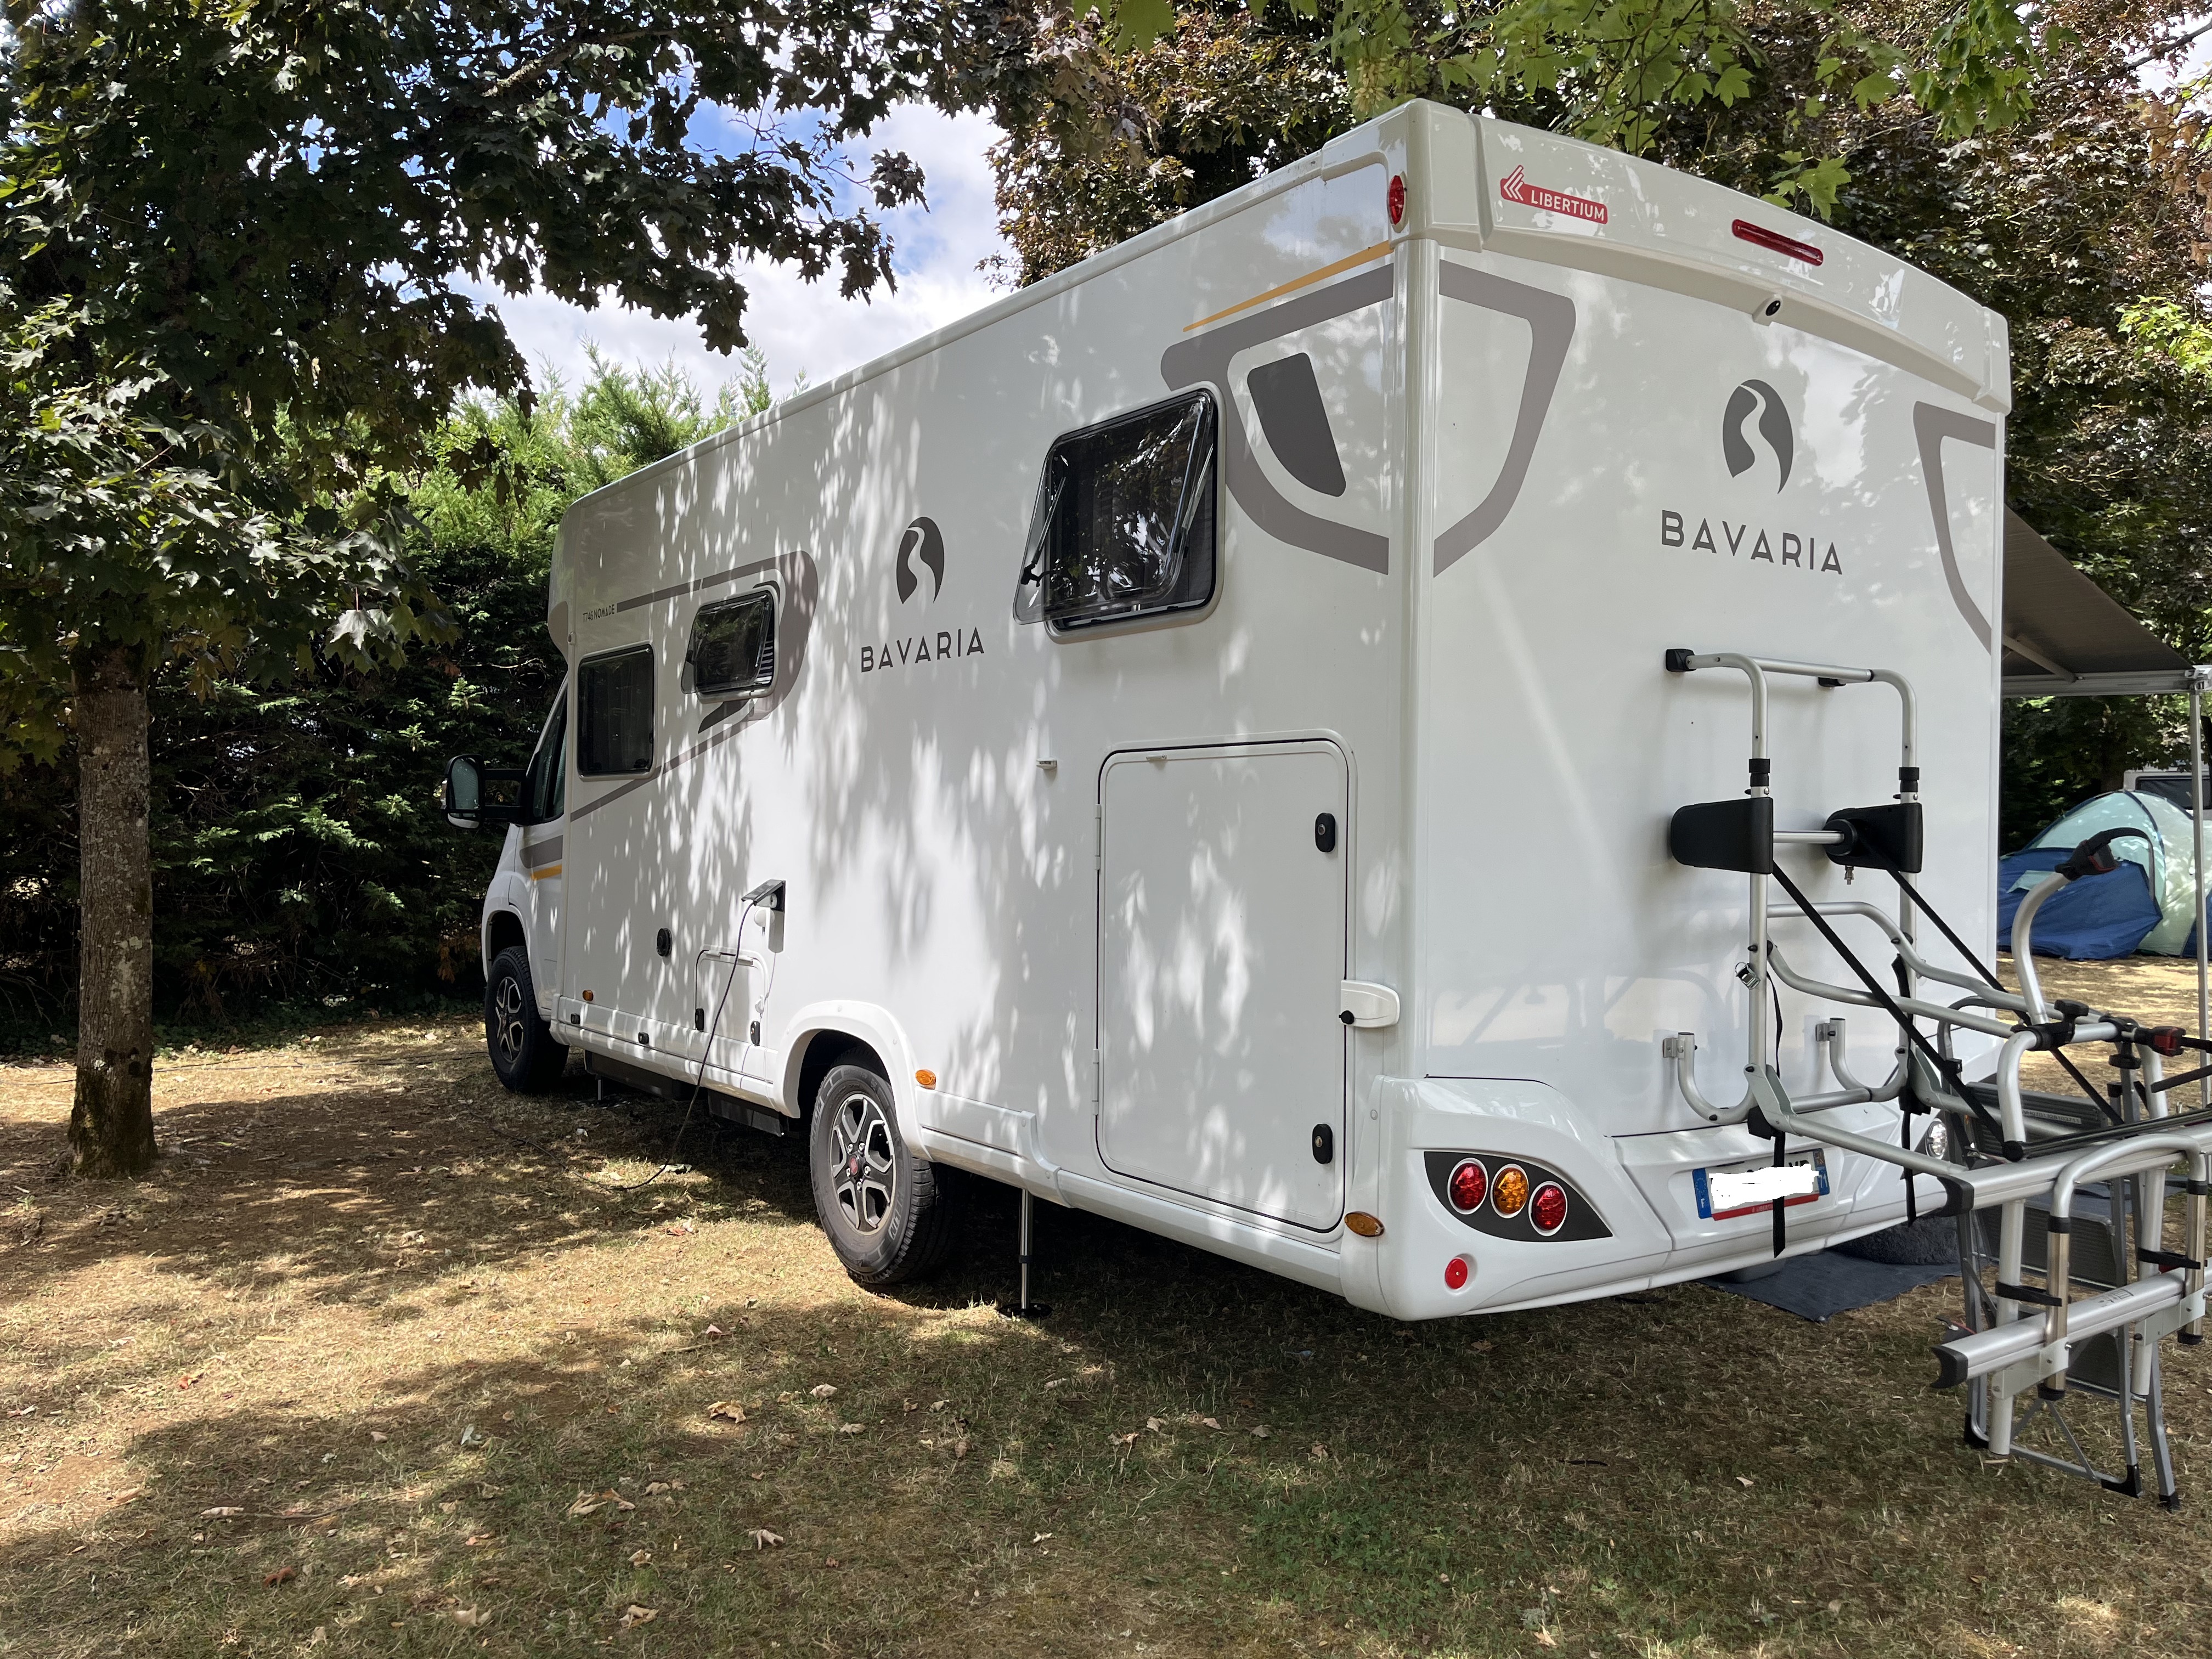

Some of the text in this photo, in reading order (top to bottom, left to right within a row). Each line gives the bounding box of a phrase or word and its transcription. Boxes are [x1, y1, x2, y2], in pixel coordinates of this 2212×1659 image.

[1531, 189, 1605, 221] LIBERTIUM
[1661, 509, 1843, 575] BAVARIA
[594, 604, 615, 619] NOMADE
[861, 626, 985, 673] BAVARIA
[1818, 1173, 1829, 1189] 71
